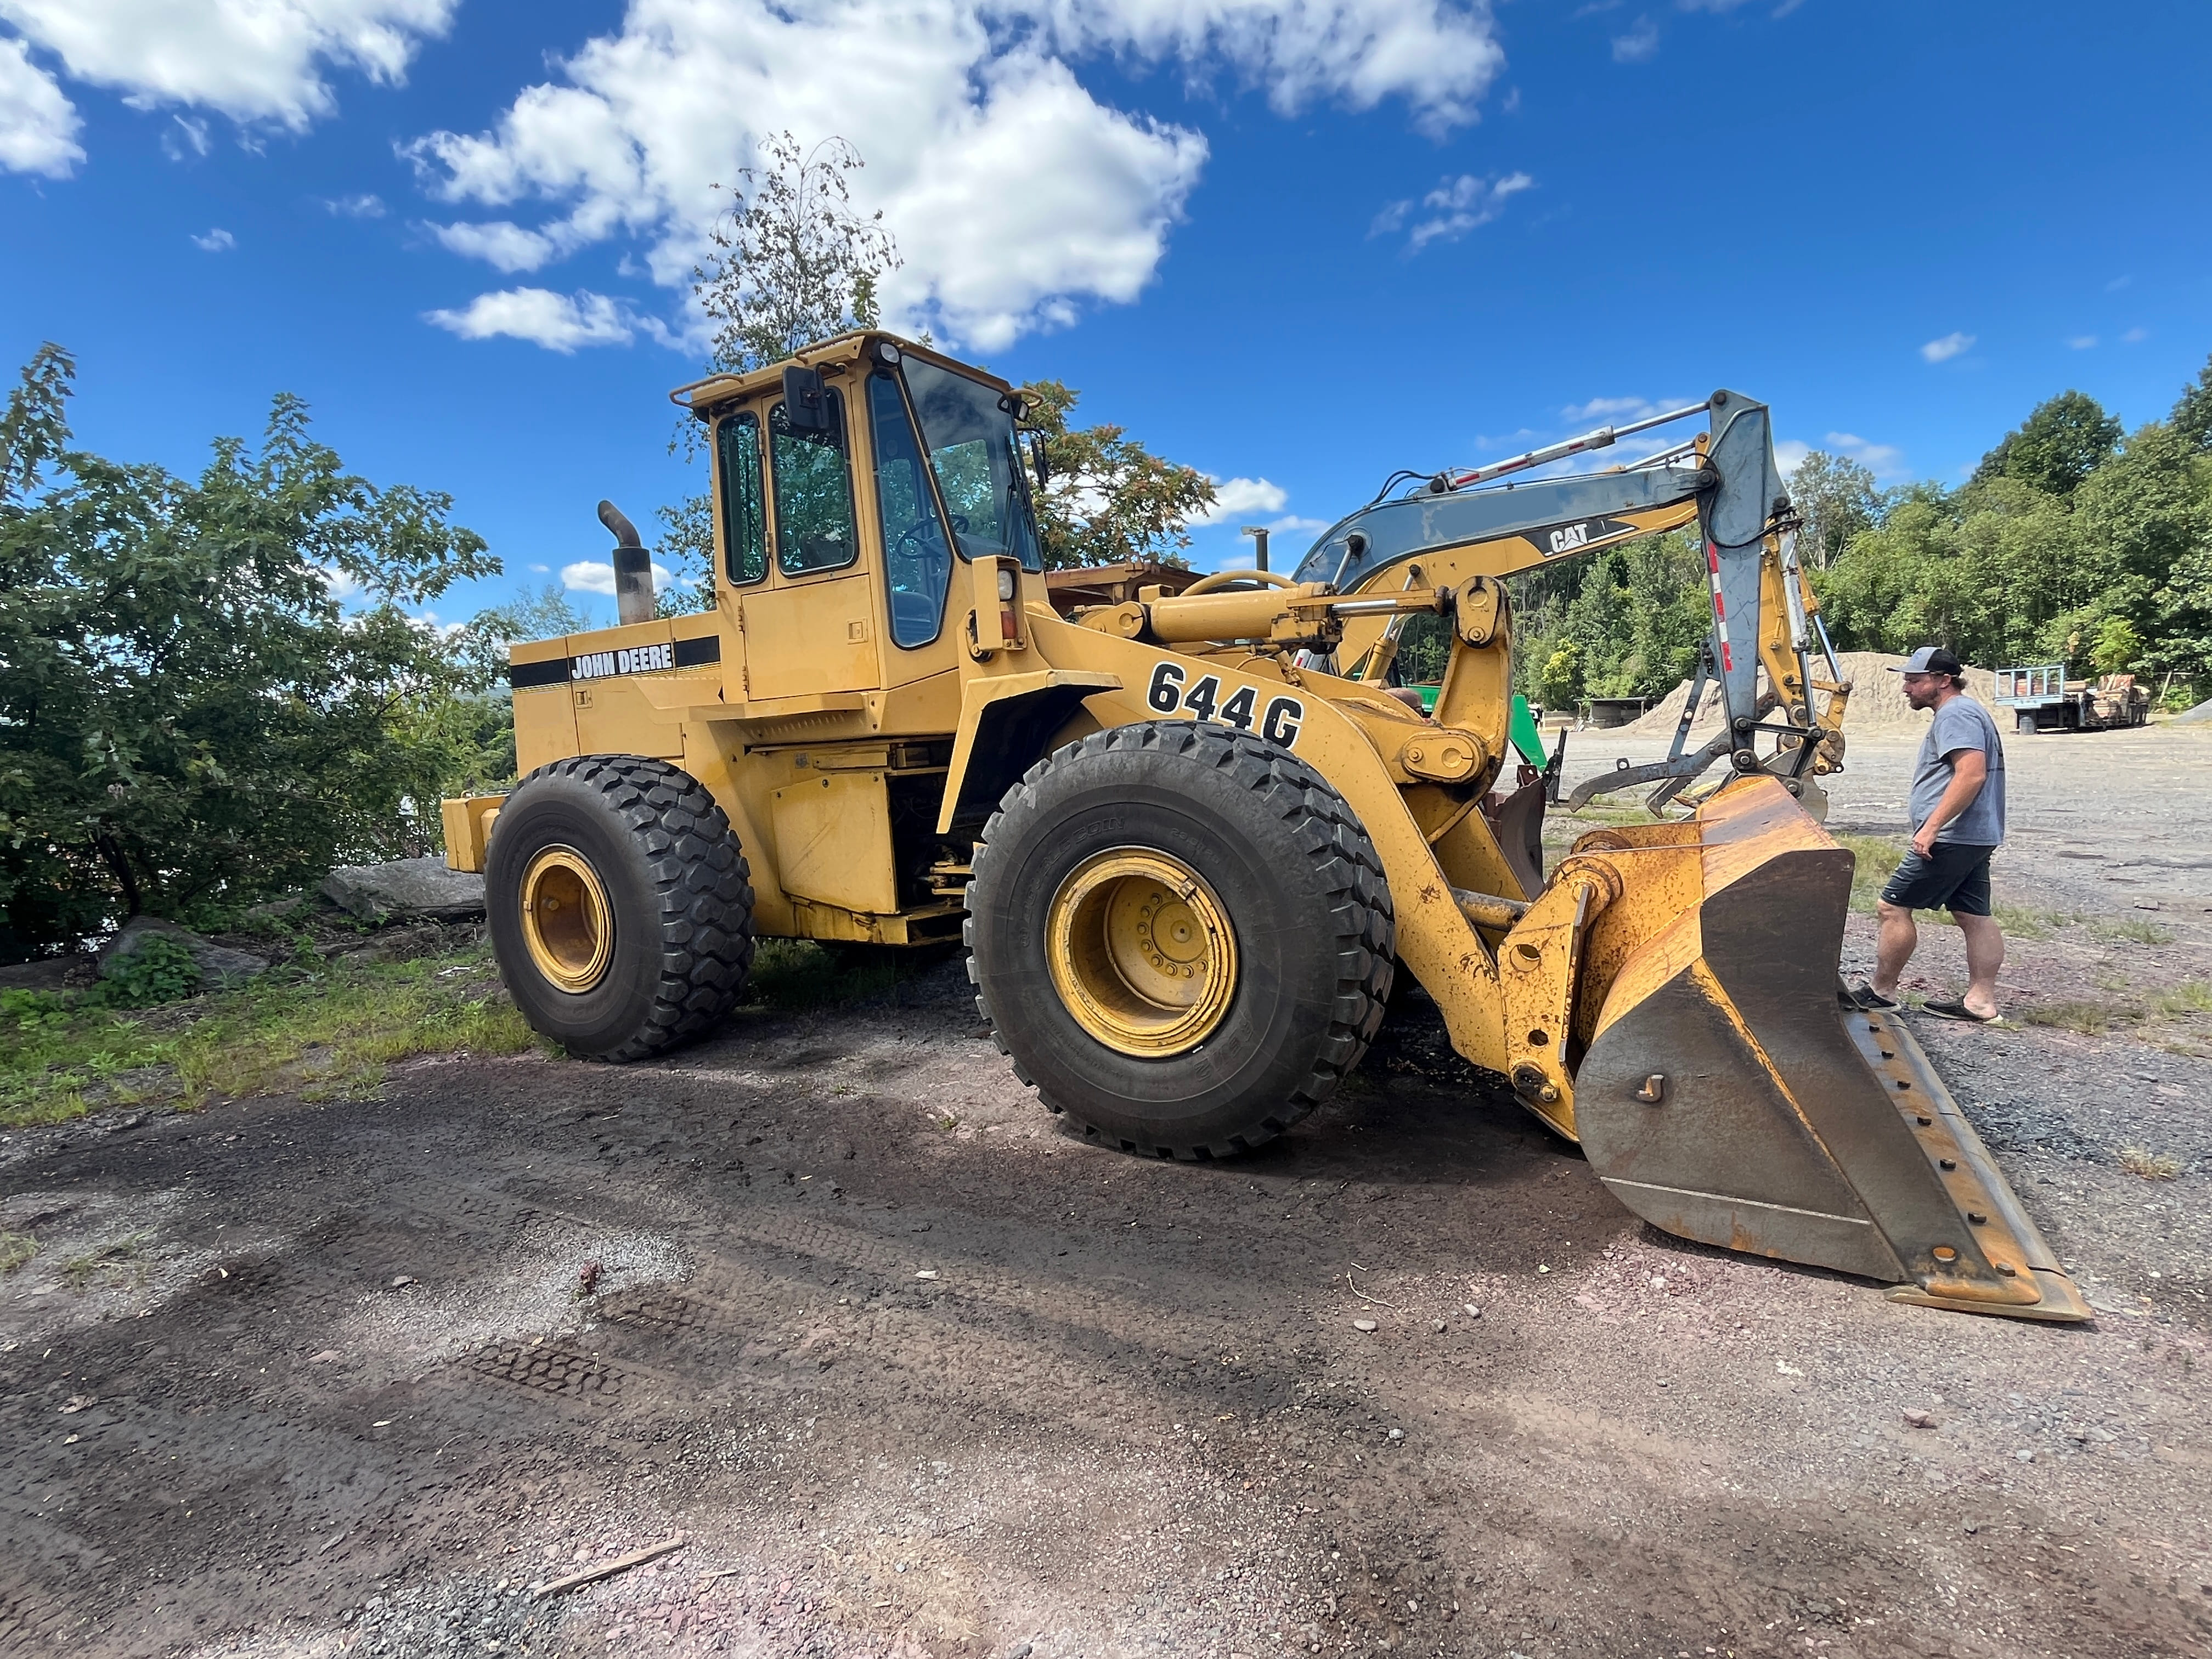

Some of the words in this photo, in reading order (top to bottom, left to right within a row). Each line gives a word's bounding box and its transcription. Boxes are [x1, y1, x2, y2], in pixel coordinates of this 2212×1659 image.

[1550, 523, 1588, 553] CAT
[572, 652, 616, 679] JOHN
[618, 644, 672, 674] DEERE
[1147, 661, 1304, 750] 644G
[1072, 817, 1126, 844] COIN
